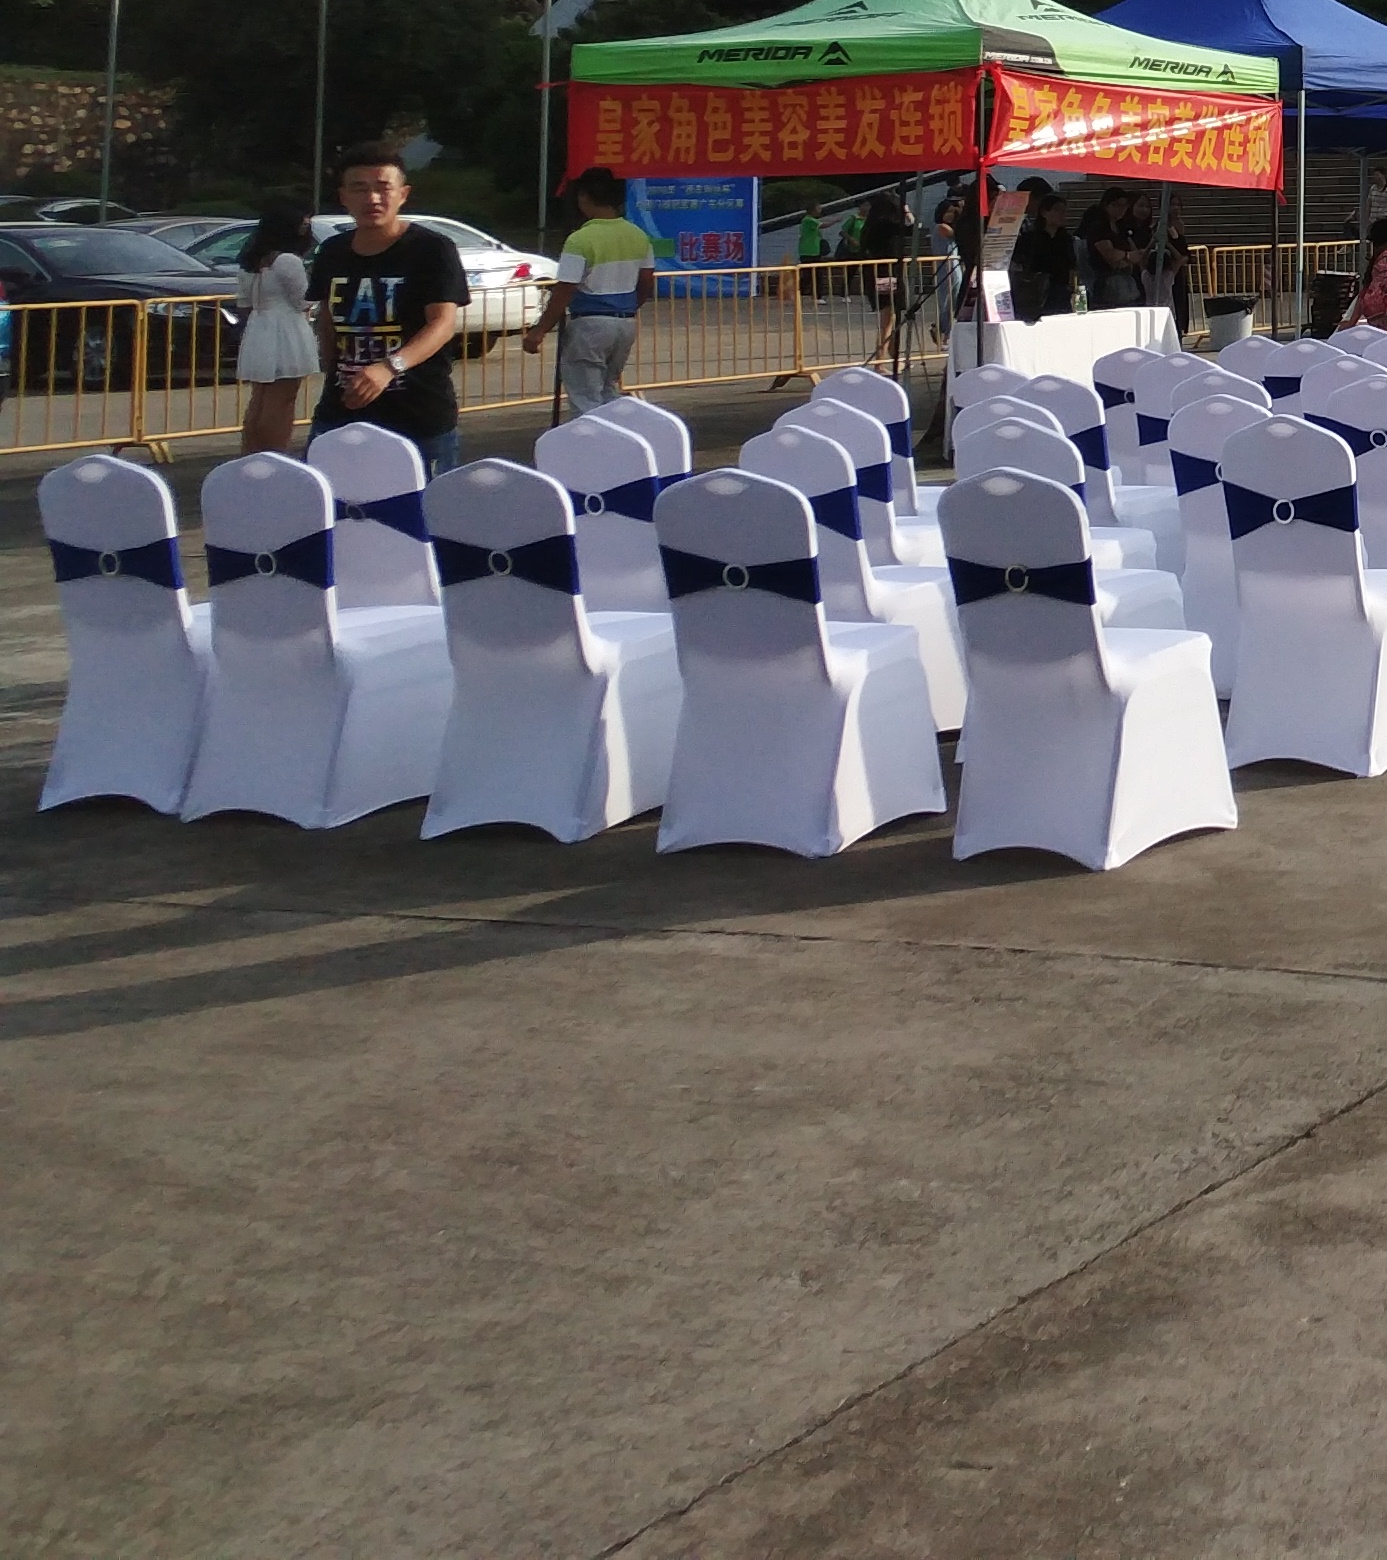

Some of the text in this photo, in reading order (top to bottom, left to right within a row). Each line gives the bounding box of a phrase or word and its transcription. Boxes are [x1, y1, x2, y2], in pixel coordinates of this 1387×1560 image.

[696, 46, 813, 64] MERIDA
[1129, 56, 1213, 79] MERIDA
[594, 81, 965, 165] 皇家角色美容美发连锁
[1006, 83, 1271, 176] 皇家角色美容美发连锁
[678, 230, 745, 263] 比赛场
[329, 277, 405, 323] EAT
